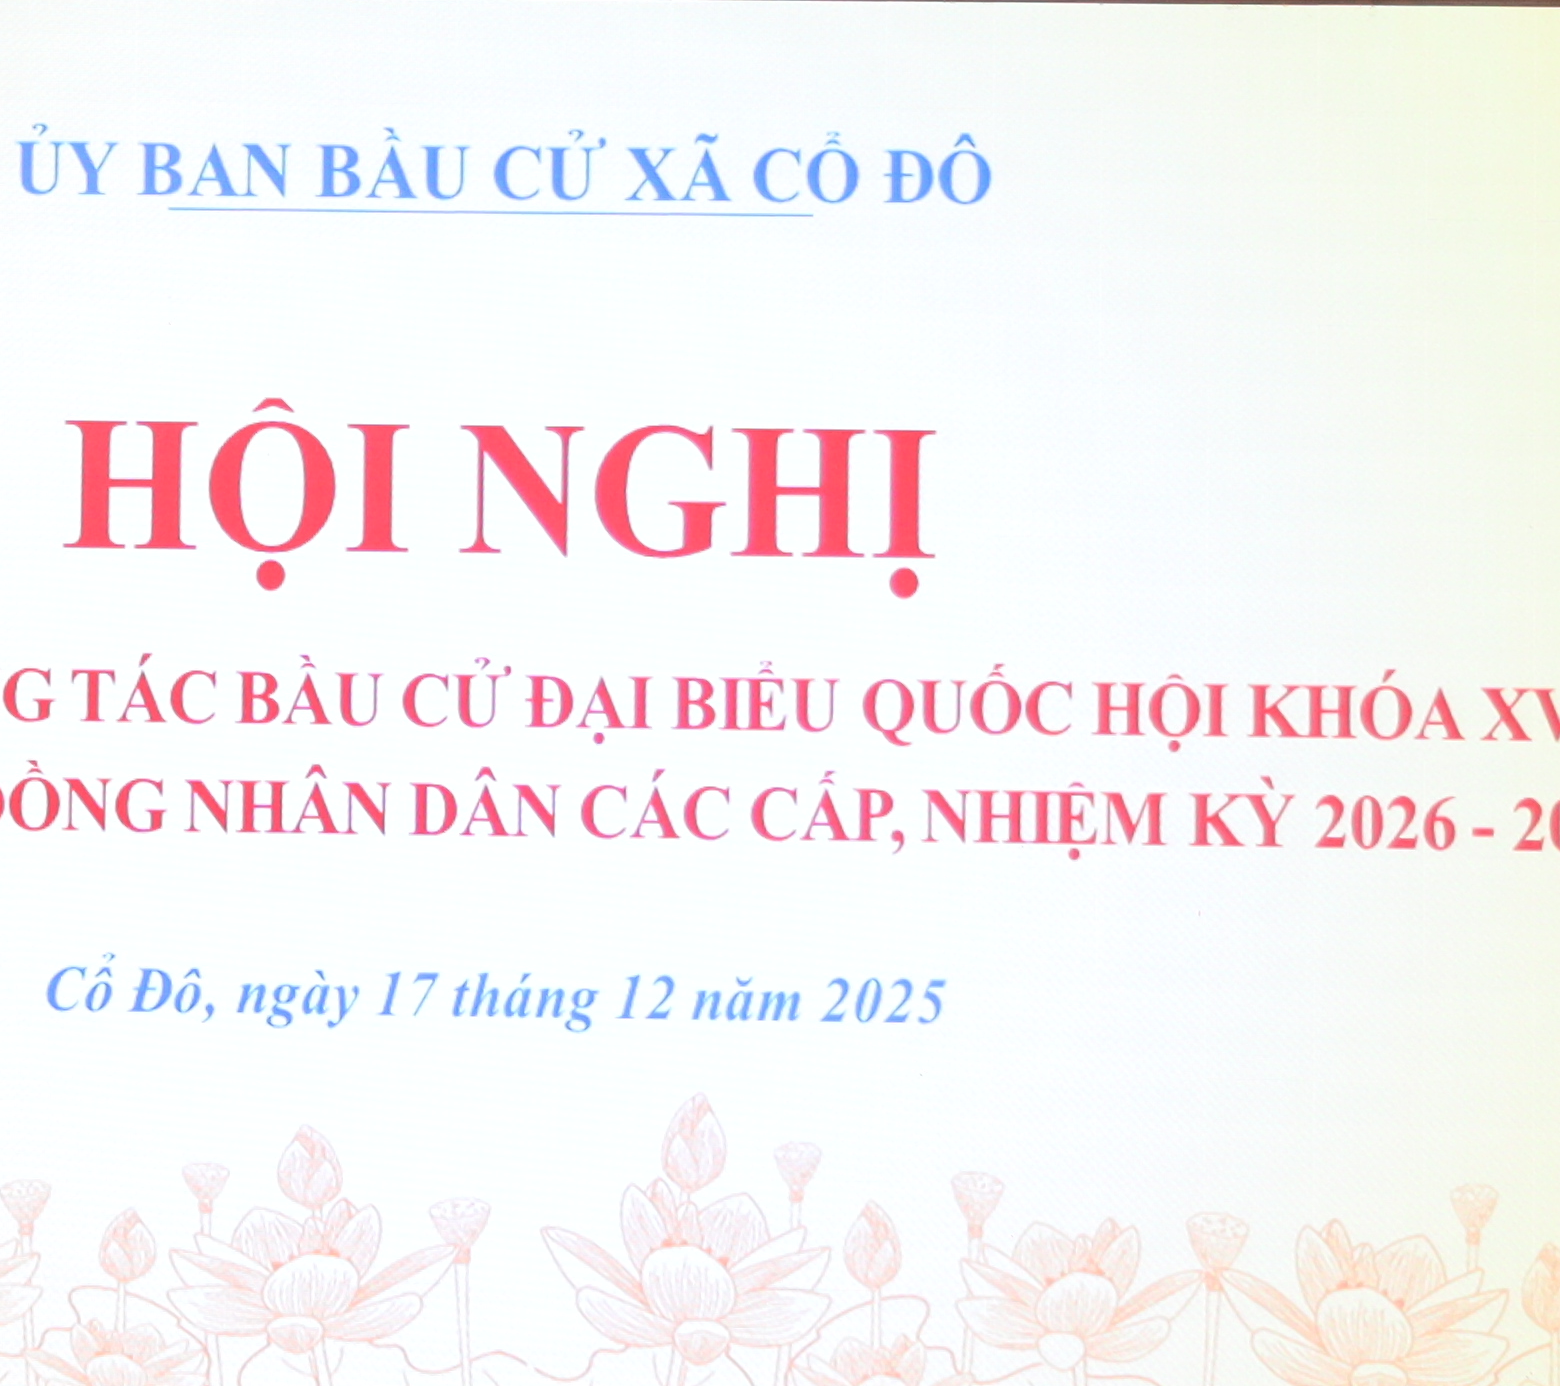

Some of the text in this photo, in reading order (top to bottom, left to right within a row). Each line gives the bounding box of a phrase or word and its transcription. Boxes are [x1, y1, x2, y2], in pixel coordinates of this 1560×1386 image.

[16, 122, 993, 206] ỦY BAN BẦU CỬ XÃ CỔ ĐÔ
[64, 397, 936, 600] HỘI NGHỊ
[73, 653, 216, 724] TÁC
[240, 655, 381, 726] BẦU
[403, 658, 511, 728] CỬ
[527, 675, 650, 744] ĐẠI
[674, 661, 840, 733] BIỂU
[864, 664, 1072, 746] QUỐC
[1093, 674, 1228, 751] HỘI
[1251, 669, 1464, 740] KHÓA
[187, 765, 389, 835] NHÂN
[413, 767, 559, 836] DÂN
[582, 769, 729, 840] CÁC
[751, 771, 906, 854] CẤP,
[923, 782, 1166, 860] NHIỆM
[1190, 776, 1294, 847] KỲ
[1315, 795, 1456, 851] 2026
[45, 952, 948, 1033] Cổ Đô, ngày 17 tháng 12 năm 2025
